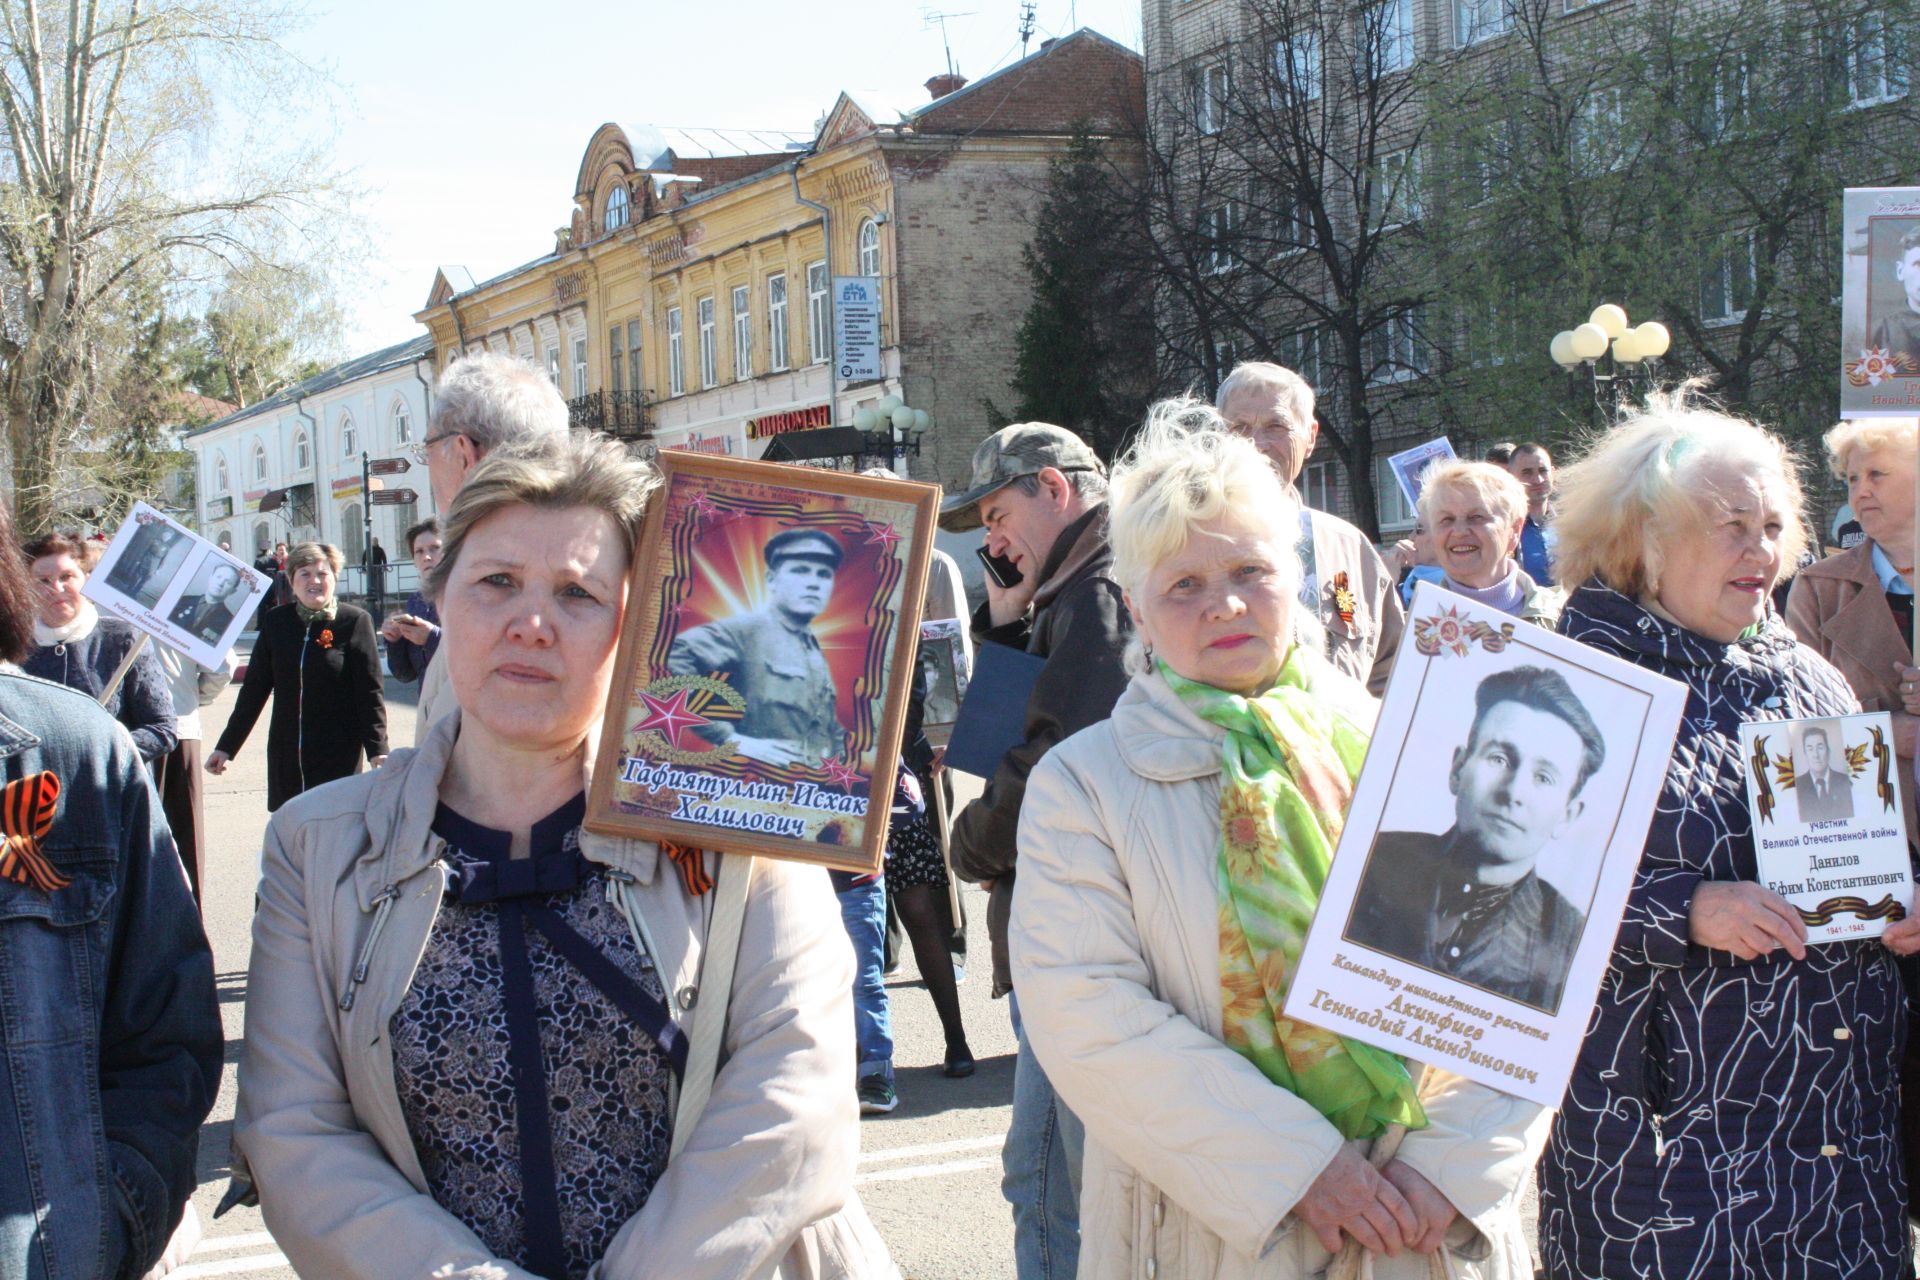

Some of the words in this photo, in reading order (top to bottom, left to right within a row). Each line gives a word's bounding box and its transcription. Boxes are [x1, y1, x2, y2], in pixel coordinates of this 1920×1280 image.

[843, 291, 867, 301] БТИ
[1904, 380, 1920, 393] Гр
[1872, 394, 1904, 405] Иван
[625, 759, 787, 803] Гафиятуллин
[793, 783, 868, 815] Исхак
[673, 795, 805, 836] Халилович
[1810, 819, 1848, 832] участник
[1762, 837, 1800, 850] Великой
[1803, 831, 1868, 847] Отечественной
[1870, 827, 1898, 840] войны
[1810, 855, 1860, 873] Данилов
[1769, 880, 1803, 897] Ефим
[1806, 872, 1905, 892] Константинович
[1826, 926, 1843, 935] 1941
[1849, 923, 1865, 933] 1945
[1332, 954, 1401, 990] Командир
[1493, 1015, 1550, 1041] расчета
[1385, 994, 1485, 1041] Акинфиев
[1309, 990, 1406, 1037] Геннадий
[1406, 1025, 1539, 1084] Акиндинович
